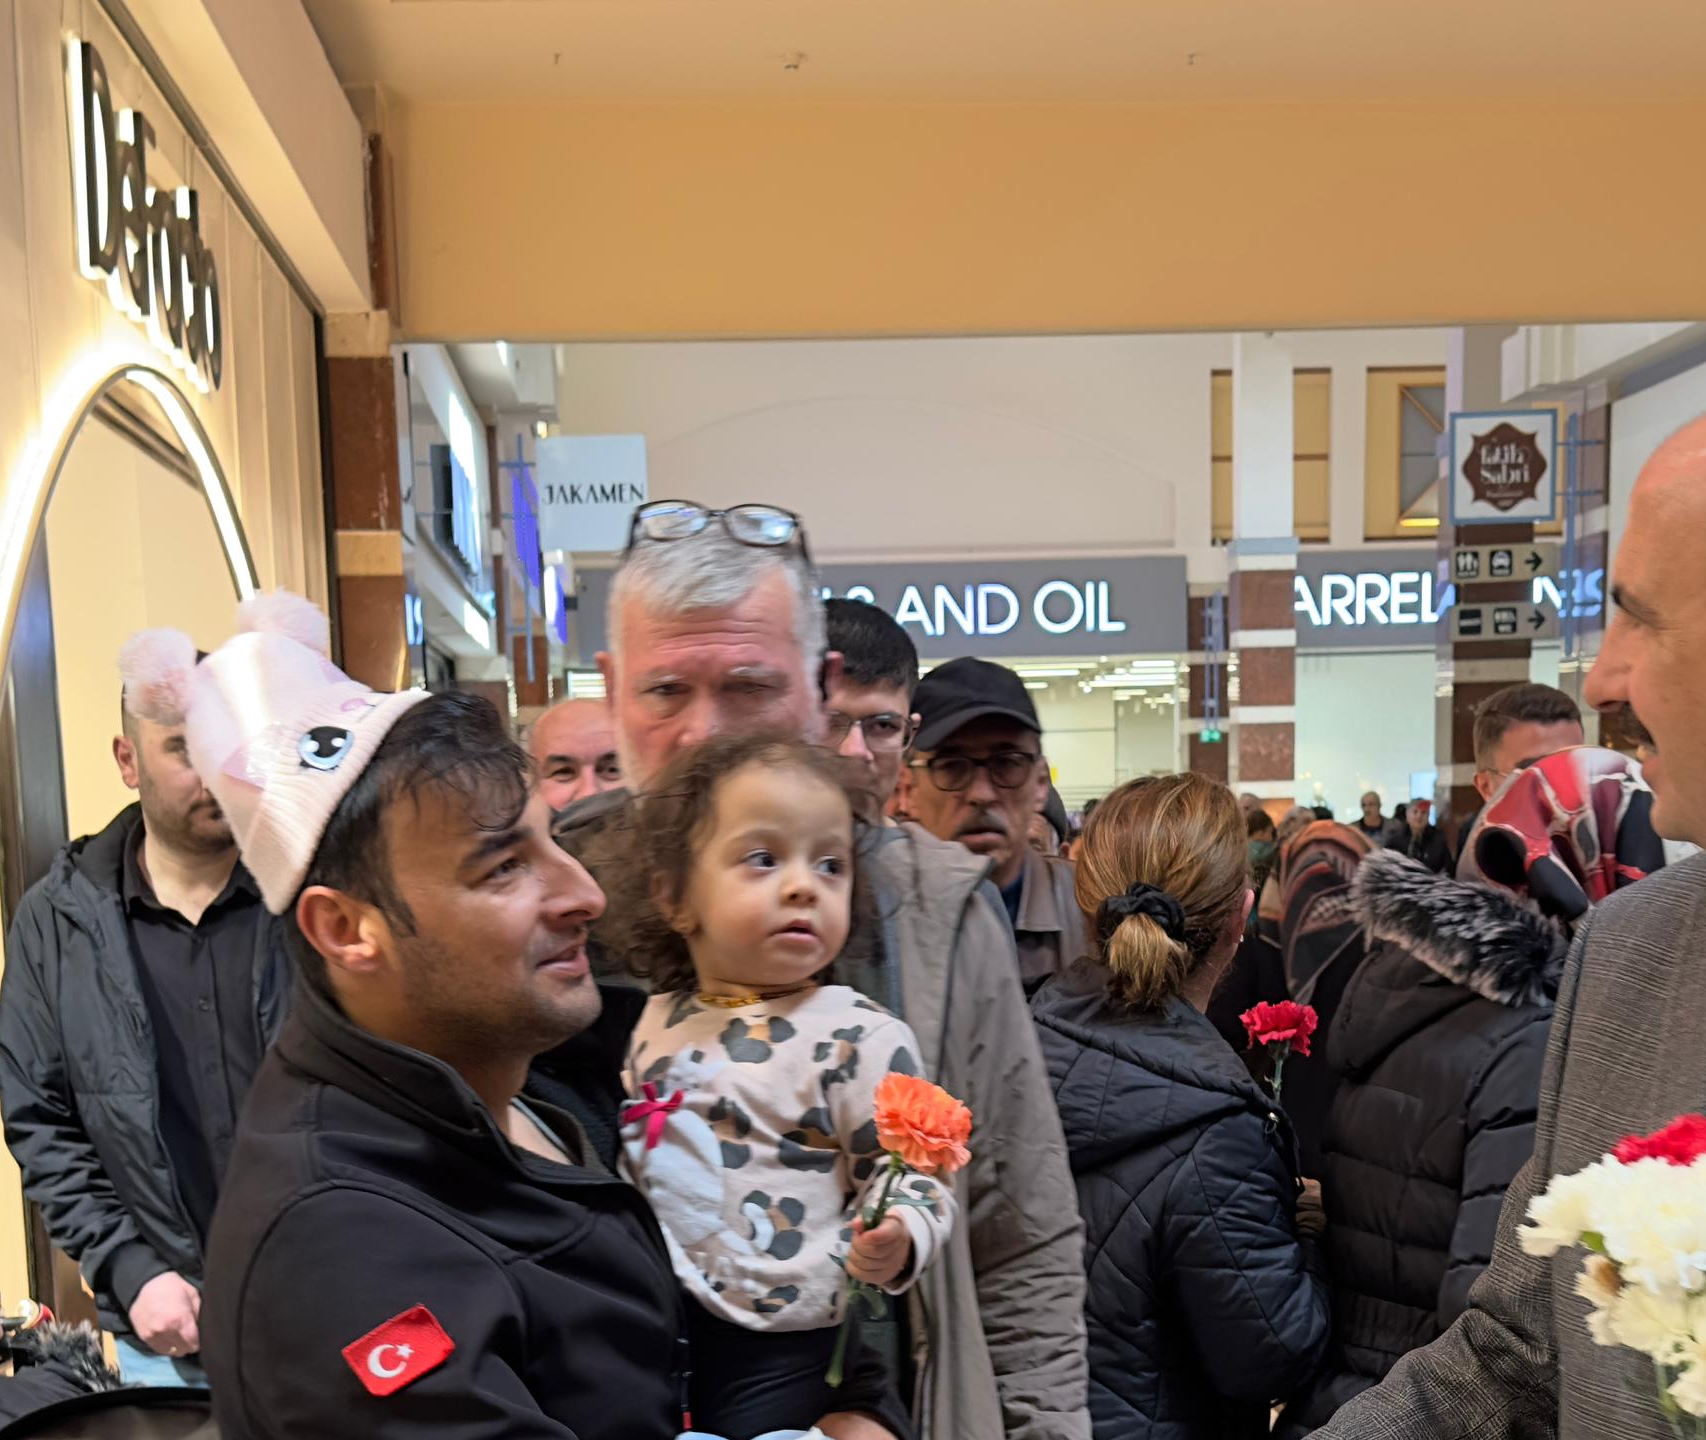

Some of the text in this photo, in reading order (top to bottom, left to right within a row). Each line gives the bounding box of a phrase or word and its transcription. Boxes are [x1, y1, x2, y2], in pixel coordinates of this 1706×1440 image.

[541, 482, 644, 506] JAKAMEN
[895, 579, 1127, 637] AND OIL
[1294, 571, 1440, 627] ARREL
